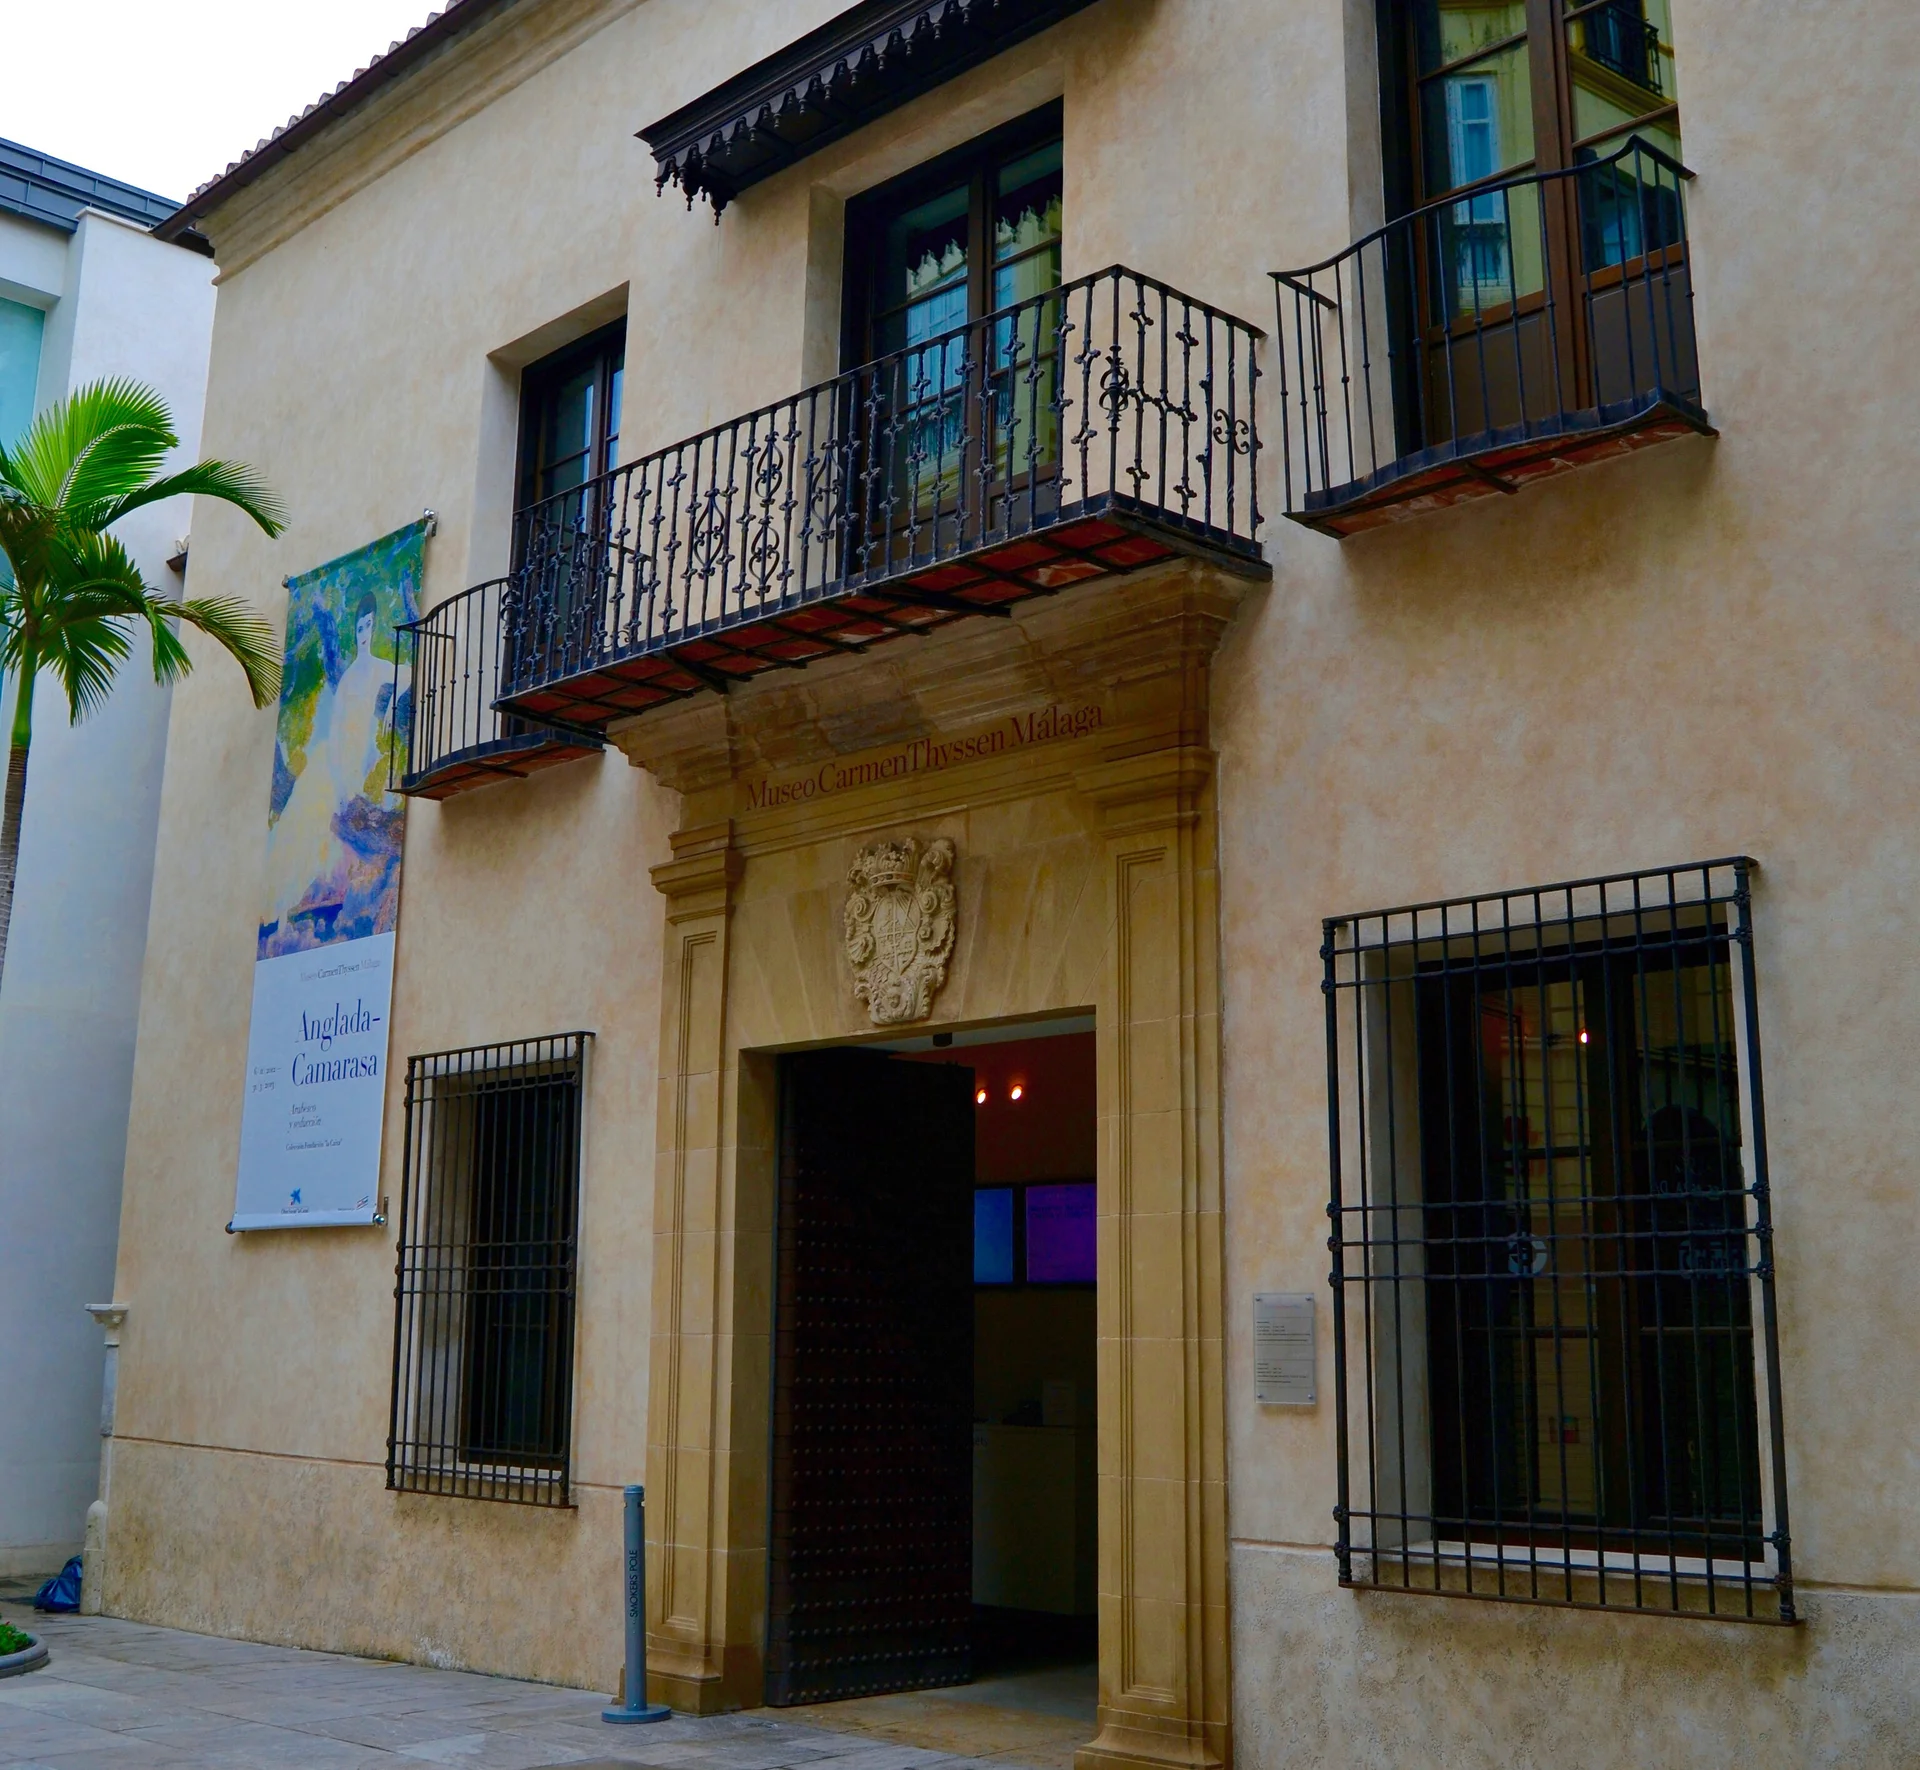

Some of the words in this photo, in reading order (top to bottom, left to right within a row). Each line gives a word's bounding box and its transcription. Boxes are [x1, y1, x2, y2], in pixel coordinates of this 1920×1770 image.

[745, 779, 816, 811] Museo
[818, 754, 908, 793] Carmen
[906, 729, 1005, 771] Thyssen
[1008, 704, 1104, 748] Málaga
[295, 998, 381, 1052] Anglada-
[292, 1053, 377, 1087] Camarasa
[629, 1549, 638, 1572] POLE
[629, 1574, 639, 1618] SMOKERS
